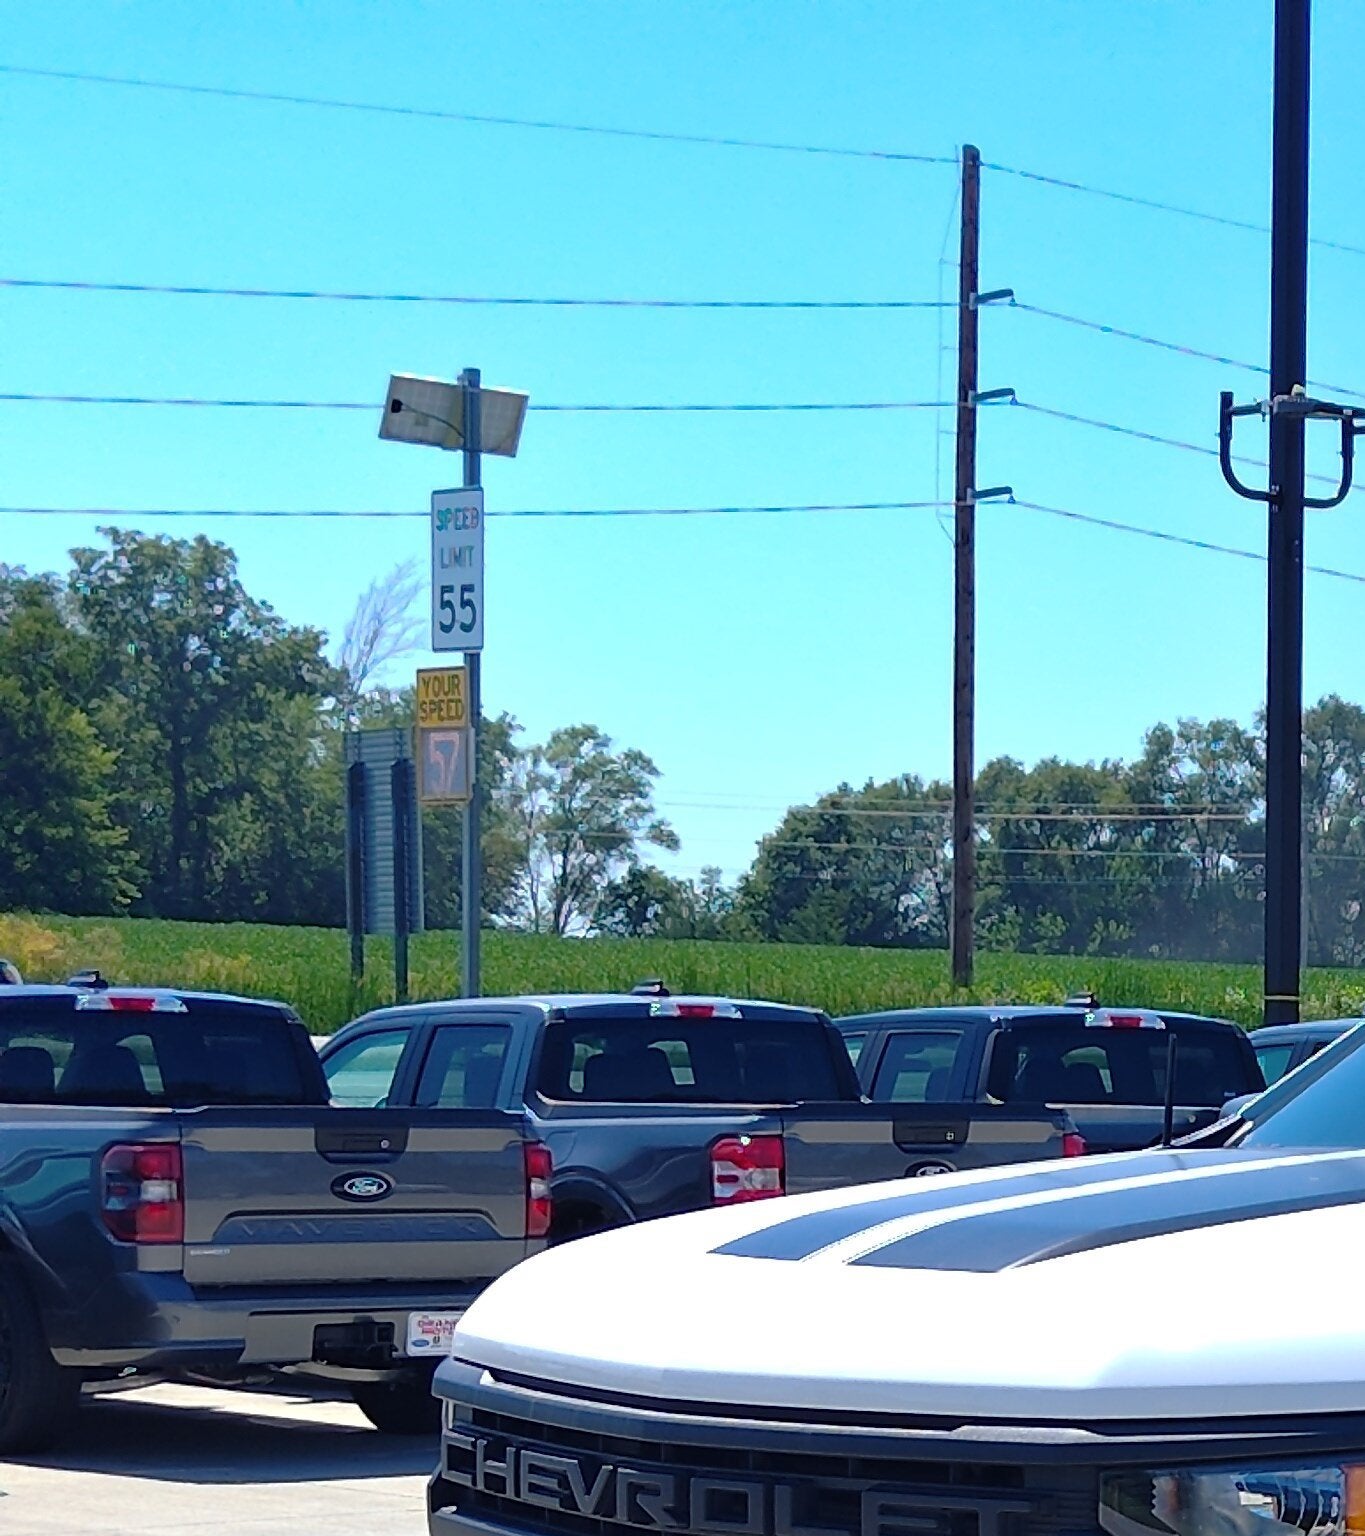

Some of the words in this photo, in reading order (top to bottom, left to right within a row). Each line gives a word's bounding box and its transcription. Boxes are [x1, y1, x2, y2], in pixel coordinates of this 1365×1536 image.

[436, 507, 479, 531] SPEED
[441, 545, 475, 569] LIMIT
[439, 583, 477, 634] 55
[421, 674, 461, 698] YOUR
[419, 698, 464, 722] SPEED
